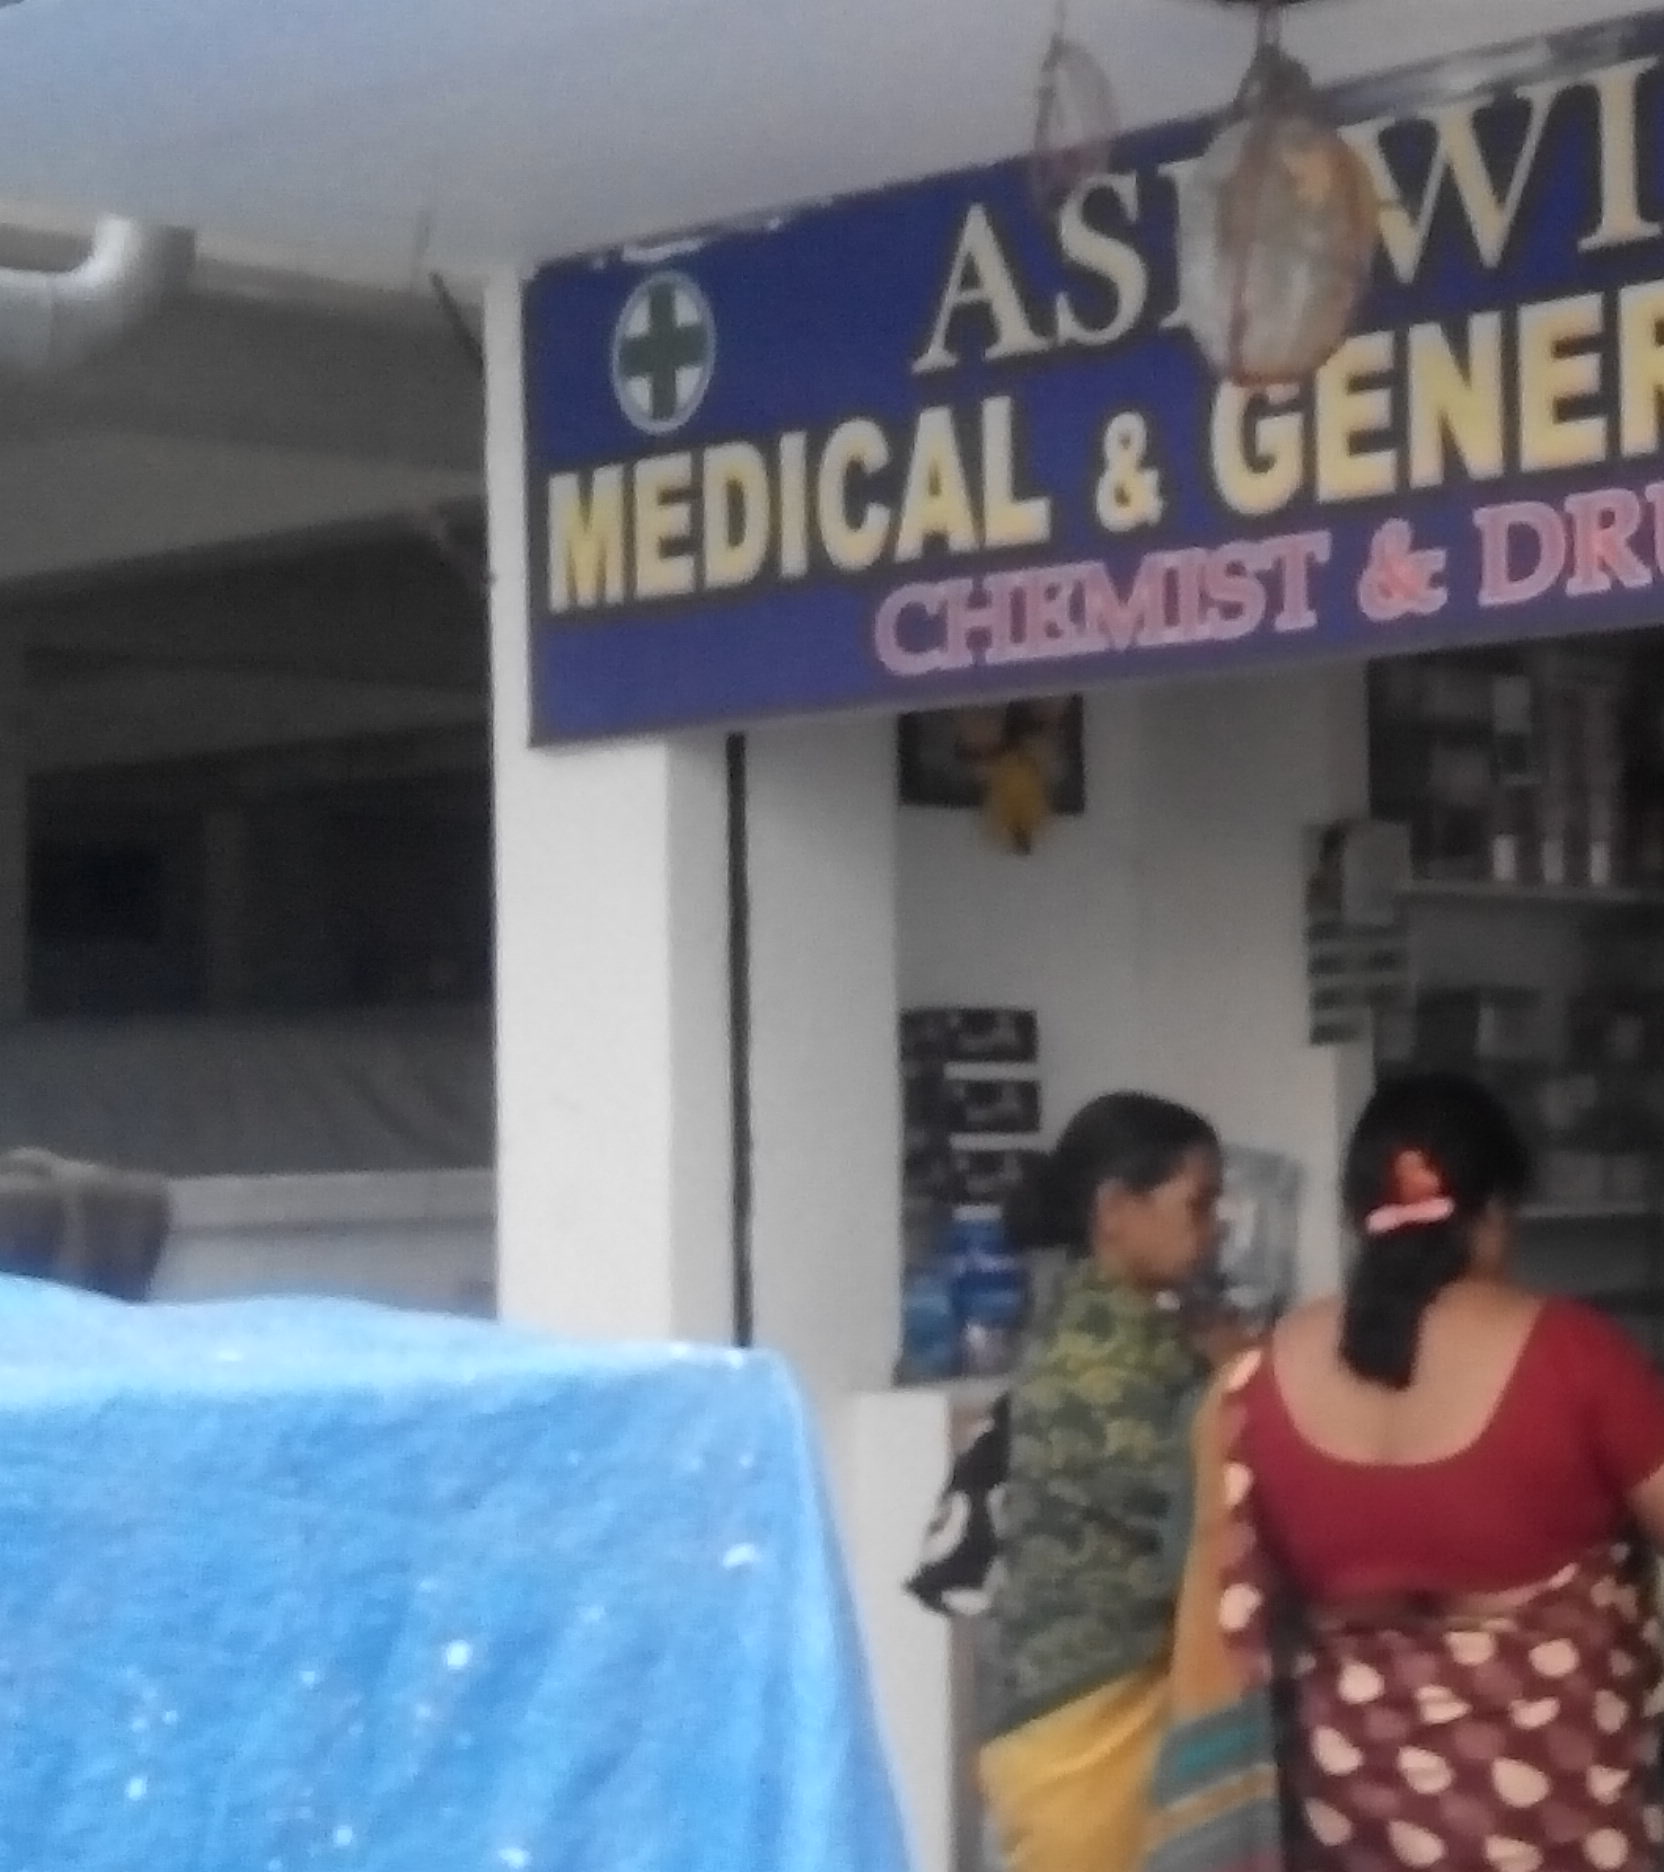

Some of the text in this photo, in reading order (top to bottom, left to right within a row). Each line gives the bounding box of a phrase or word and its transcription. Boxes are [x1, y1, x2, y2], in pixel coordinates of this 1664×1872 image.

[548, 395, 1050, 613] MEDICAL
[1095, 411, 1164, 532] &
[873, 531, 1332, 676] CHEMIST
[1357, 518, 1448, 621] &
